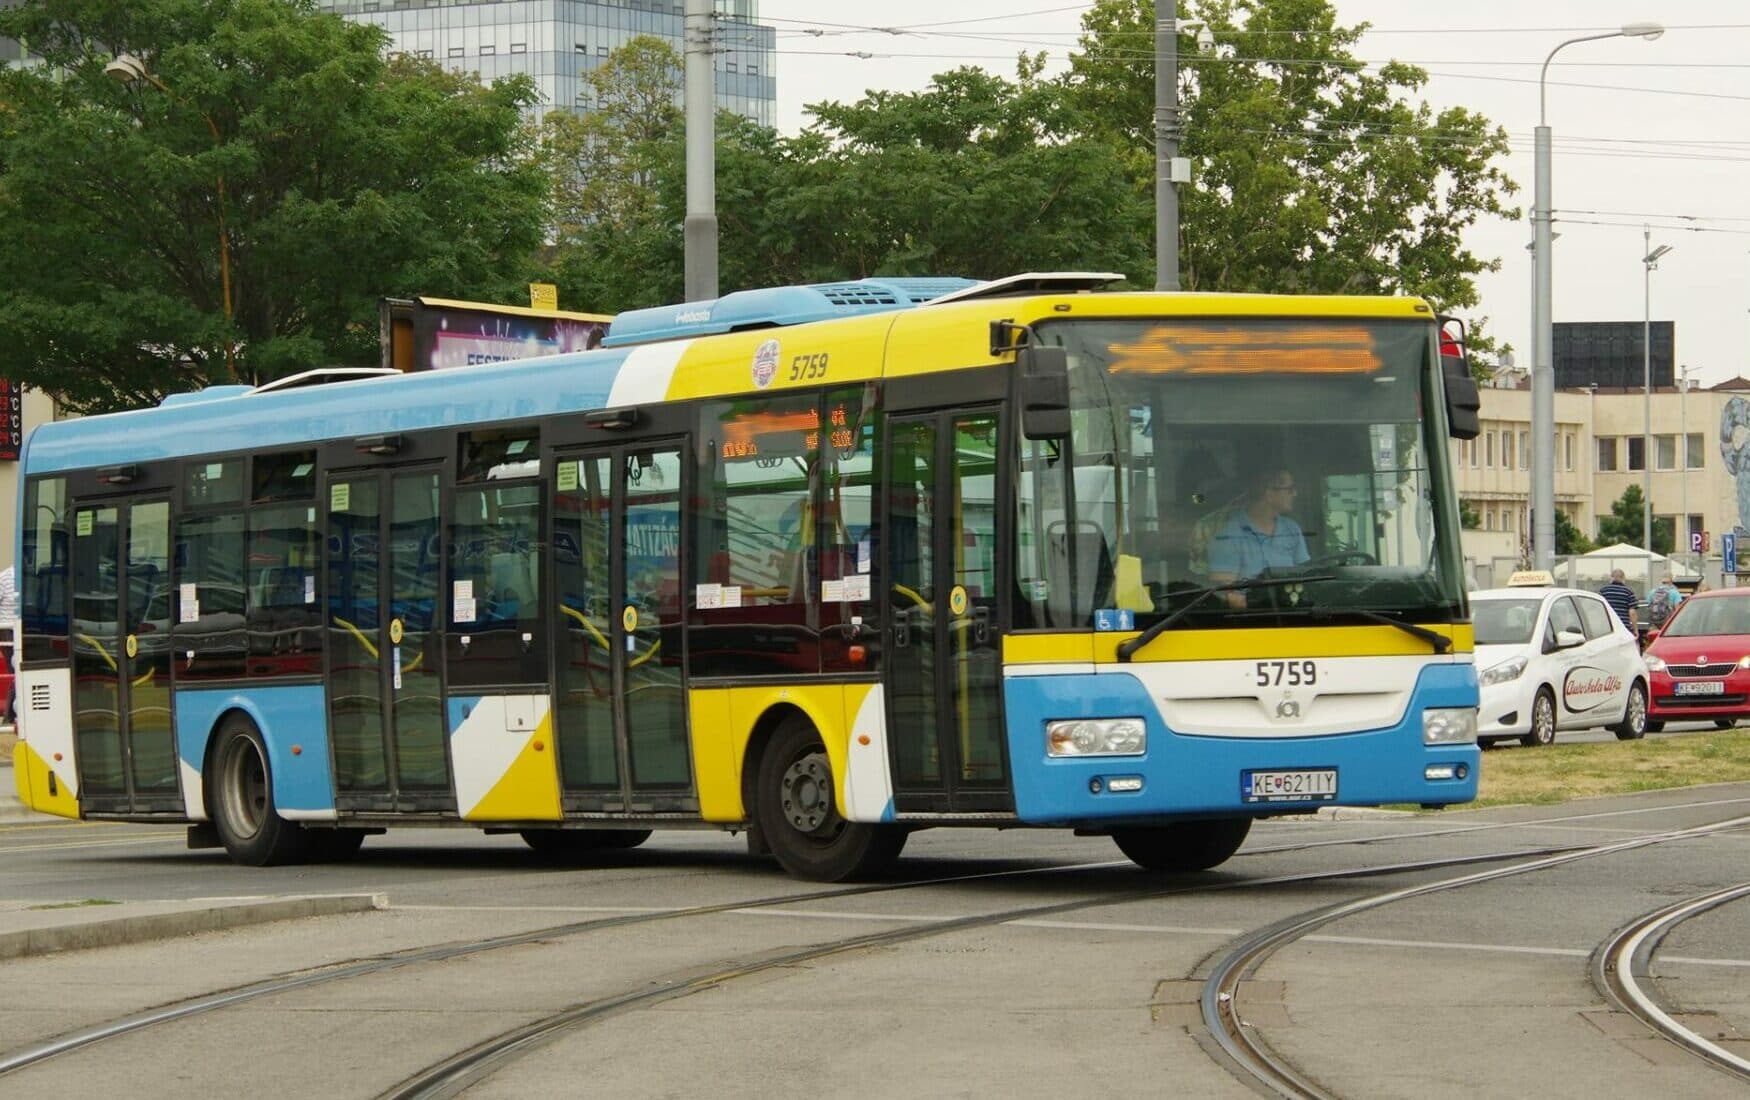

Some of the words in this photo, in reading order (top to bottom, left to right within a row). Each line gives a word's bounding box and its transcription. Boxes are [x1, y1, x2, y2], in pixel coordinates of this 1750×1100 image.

[790, 353, 828, 381] 5759
[1691, 533, 1702, 550] P
[1725, 536, 1733, 561] P
[1256, 660, 1317, 687] 5759
